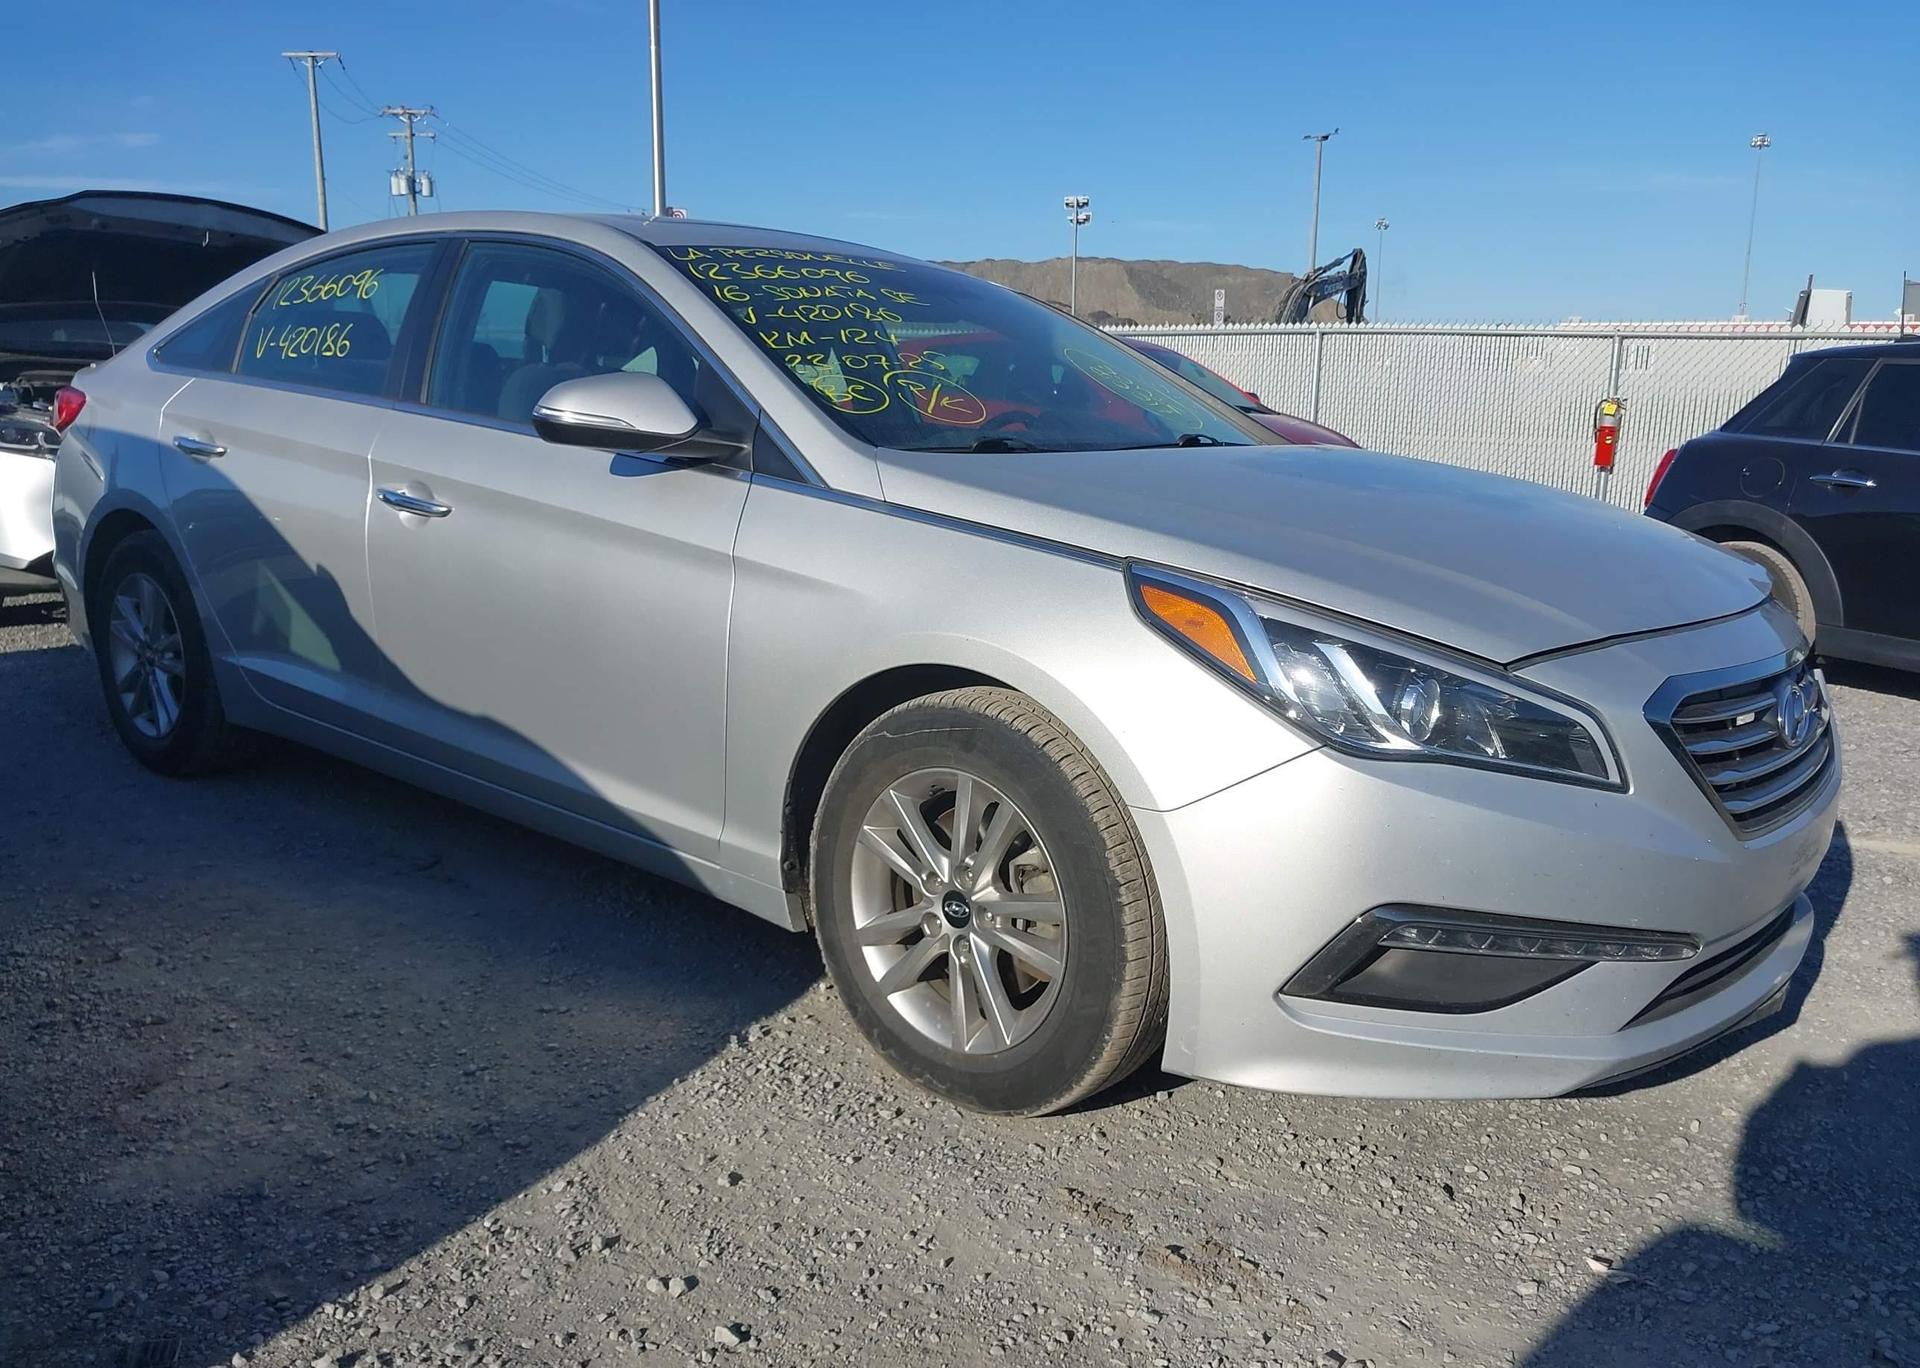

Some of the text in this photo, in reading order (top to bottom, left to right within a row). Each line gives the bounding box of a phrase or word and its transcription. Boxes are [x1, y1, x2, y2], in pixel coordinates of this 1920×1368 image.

[665, 247, 713, 261] LA
[686, 262, 871, 285] 12366096
[272, 268, 385, 311] 12366096
[255, 322, 354, 360] V-420186
